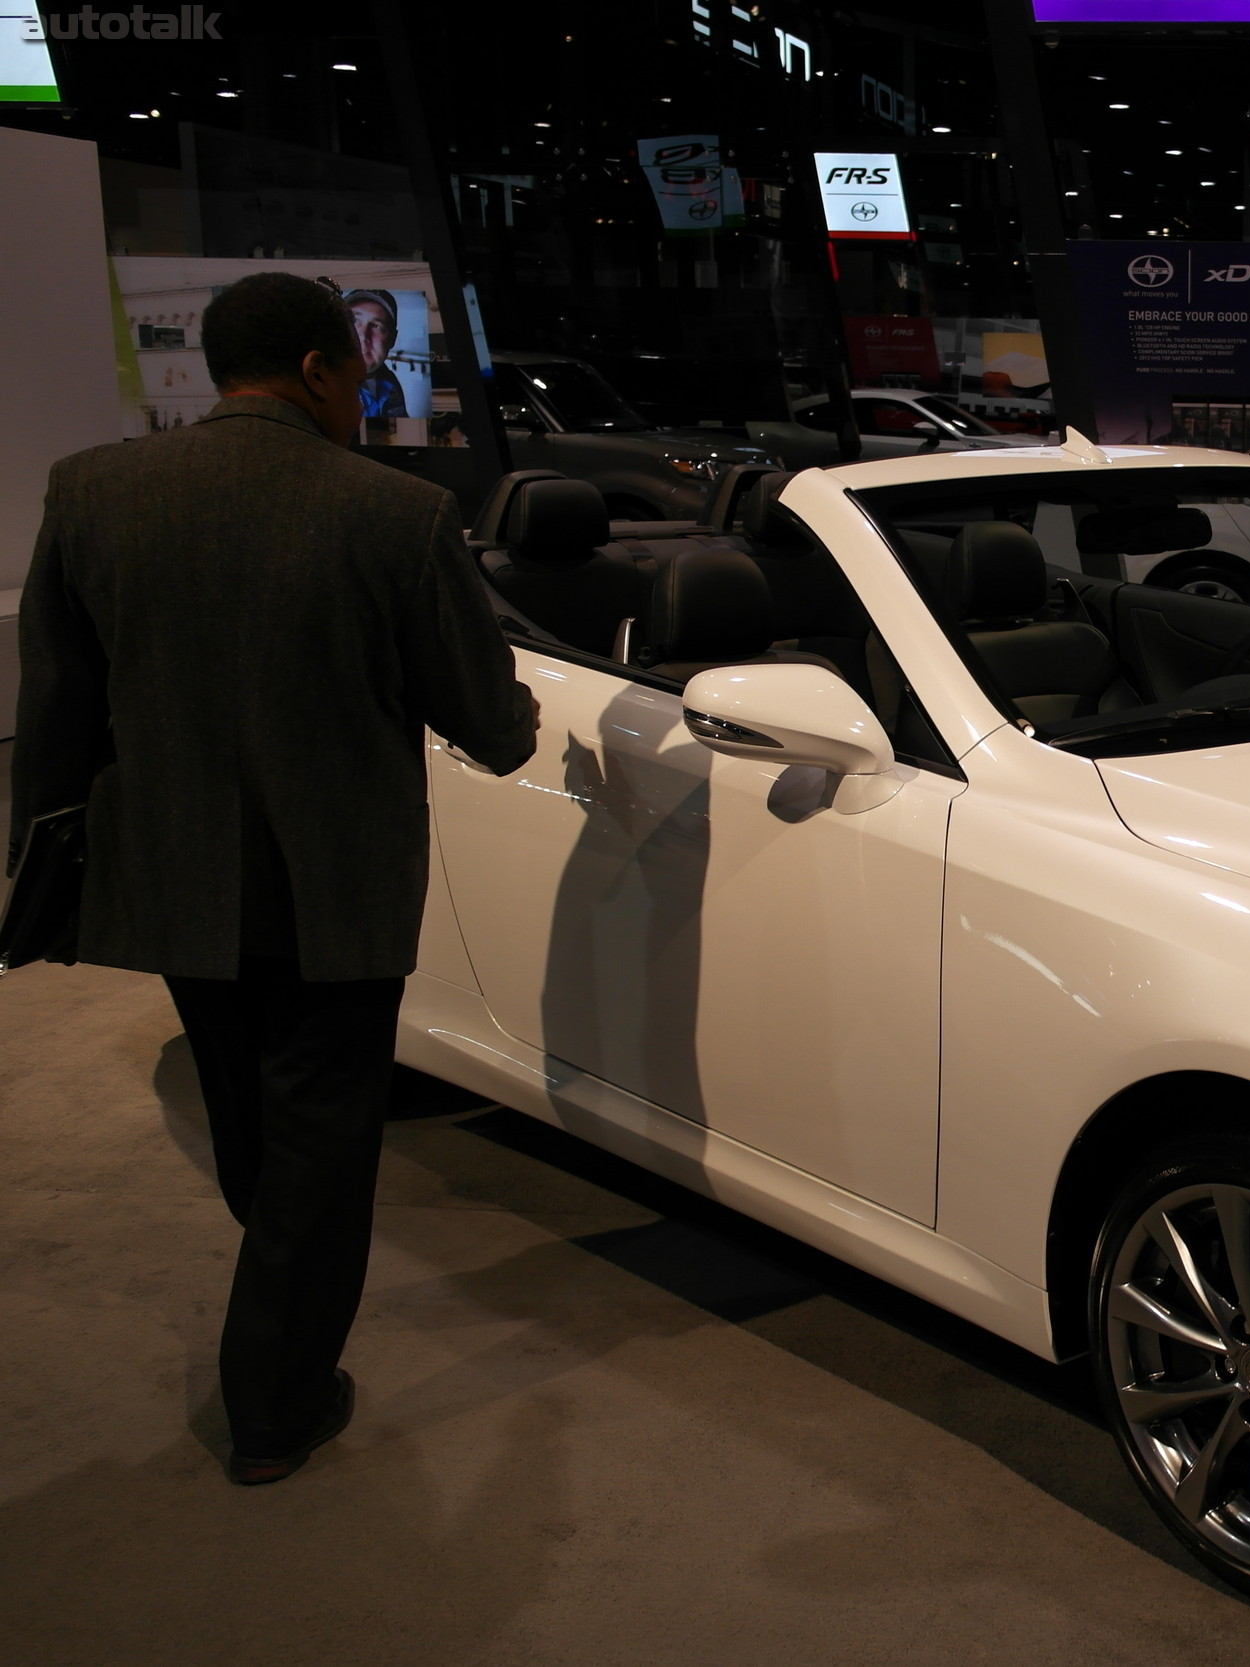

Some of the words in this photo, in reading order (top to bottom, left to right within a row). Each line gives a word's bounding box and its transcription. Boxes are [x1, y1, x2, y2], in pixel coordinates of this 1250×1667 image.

[826, 168, 890, 184] FR-S
[1128, 310, 1182, 321] EMBRACE
[1185, 311, 1215, 322] YOUR
[1217, 312, 1248, 322] GOOD
